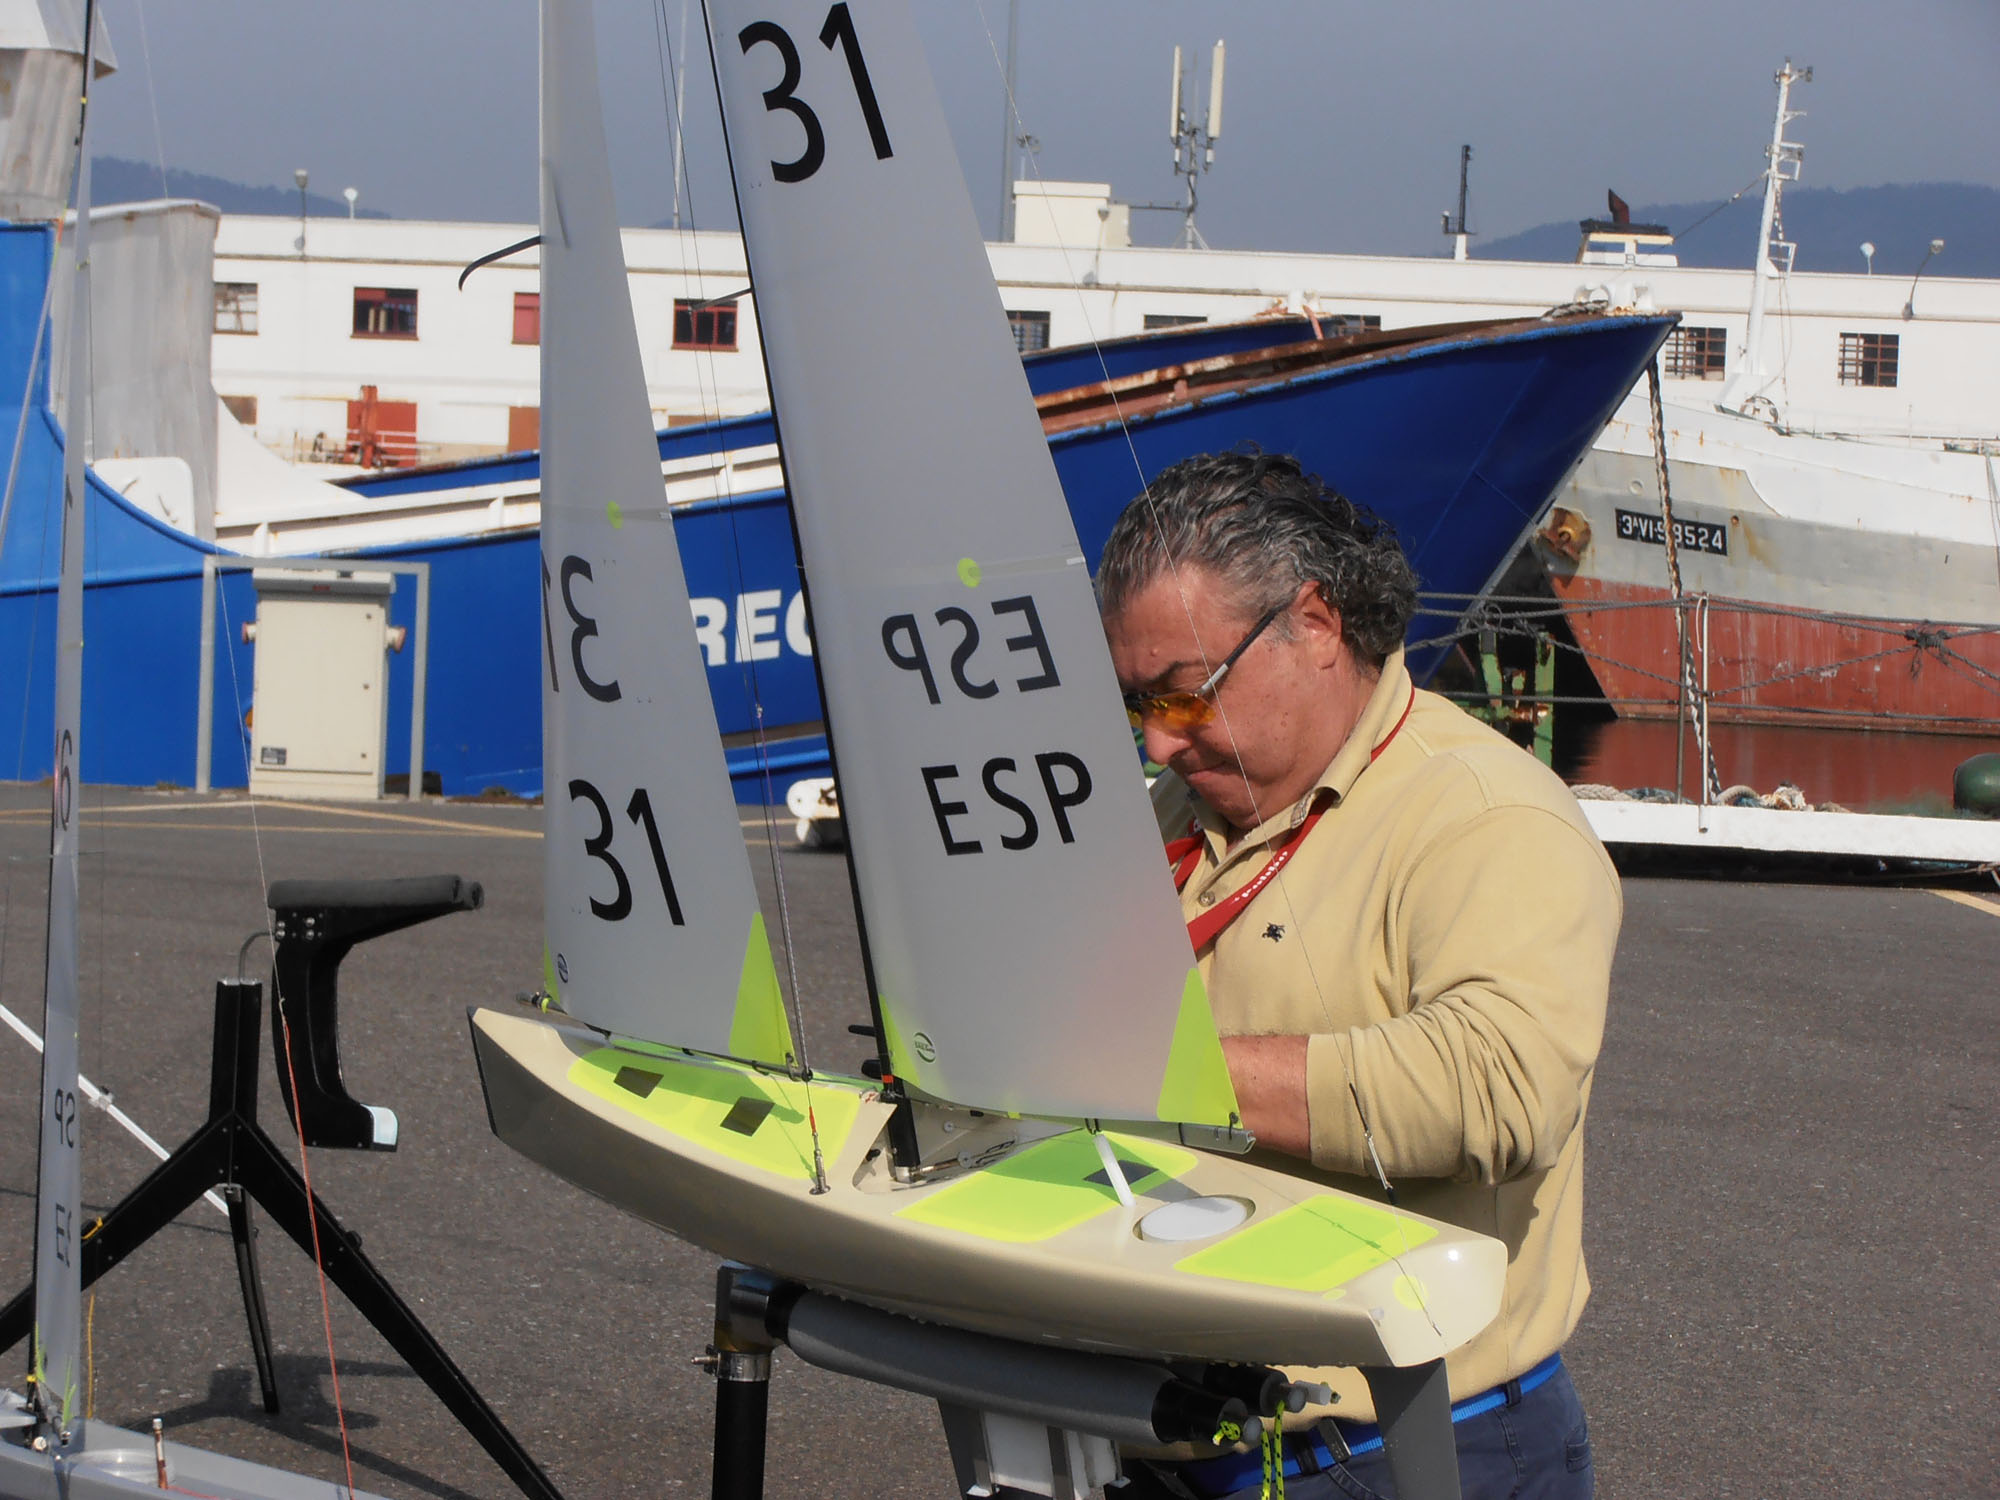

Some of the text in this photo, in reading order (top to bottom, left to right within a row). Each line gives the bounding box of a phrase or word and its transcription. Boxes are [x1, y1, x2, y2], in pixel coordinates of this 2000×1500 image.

[738, 1, 894, 183] 31
[568, 779, 685, 926] 31
[921, 752, 1093, 856] ESP
